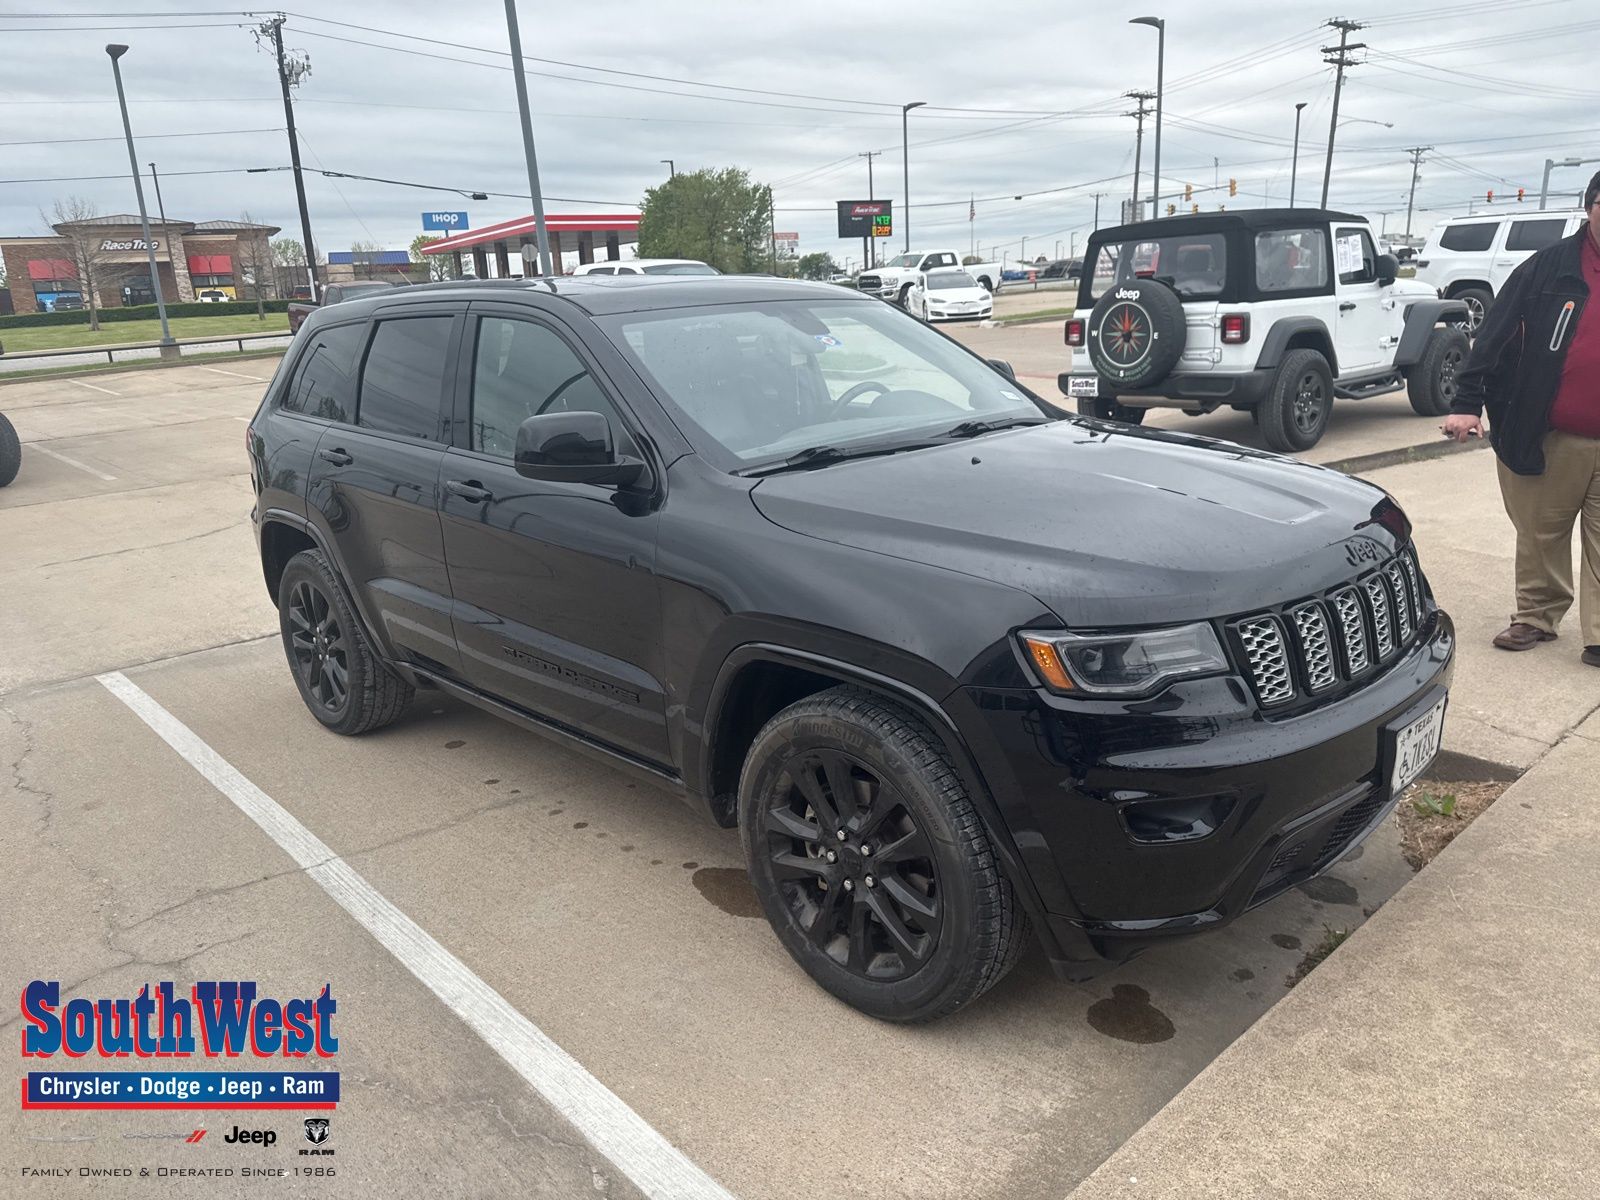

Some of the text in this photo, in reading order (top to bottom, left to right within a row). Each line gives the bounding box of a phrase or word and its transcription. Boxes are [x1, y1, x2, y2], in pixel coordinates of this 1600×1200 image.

[100, 239, 159, 251] RaceTrac
[1115, 287, 1140, 301] Jeep
[1153, 332, 1159, 340] E
[1344, 540, 1378, 567] Jeep
